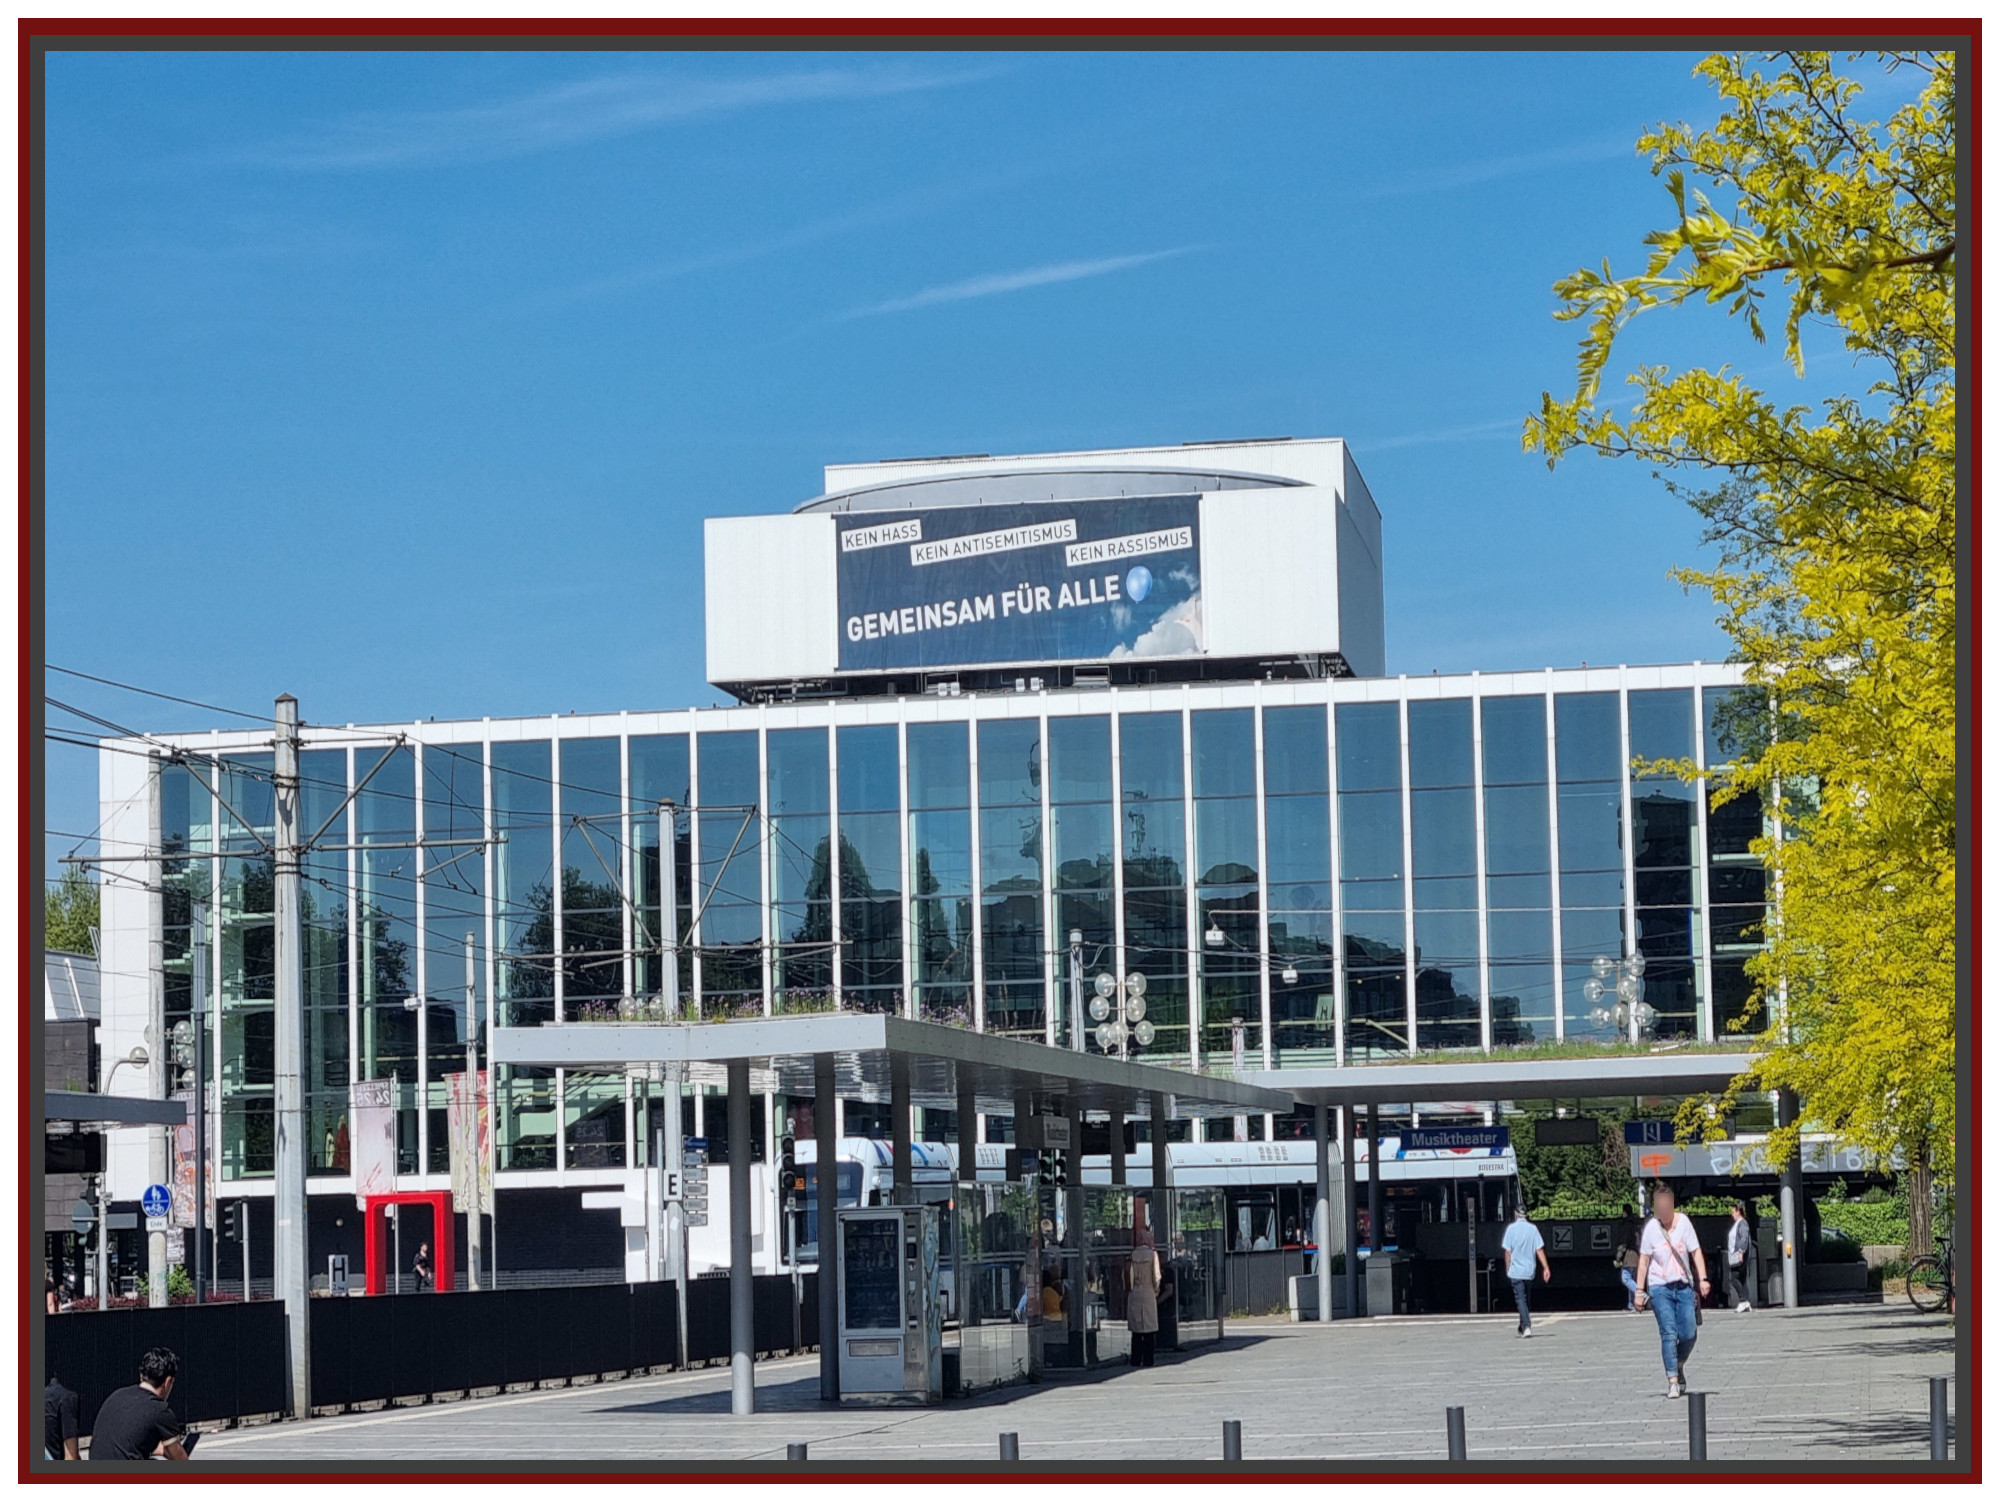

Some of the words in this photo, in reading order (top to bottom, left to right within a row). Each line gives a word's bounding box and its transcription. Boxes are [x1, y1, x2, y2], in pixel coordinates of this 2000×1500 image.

[845, 530, 879, 548] KEIN
[882, 523, 919, 542] HASS
[915, 544, 949, 562] KEIN
[952, 523, 1073, 556] ANTISEMITISMUS
[1070, 544, 1104, 563] KEIN
[1108, 531, 1189, 557] RASSISMUS
[846, 594, 996, 642] GEMEINSAM
[1001, 582, 1053, 618] FÜR
[1057, 574, 1121, 609] ALLE
[1411, 1132, 1498, 1147] Musiktheater
[668, 1173, 678, 1196] E
[332, 1257, 346, 1282] H
